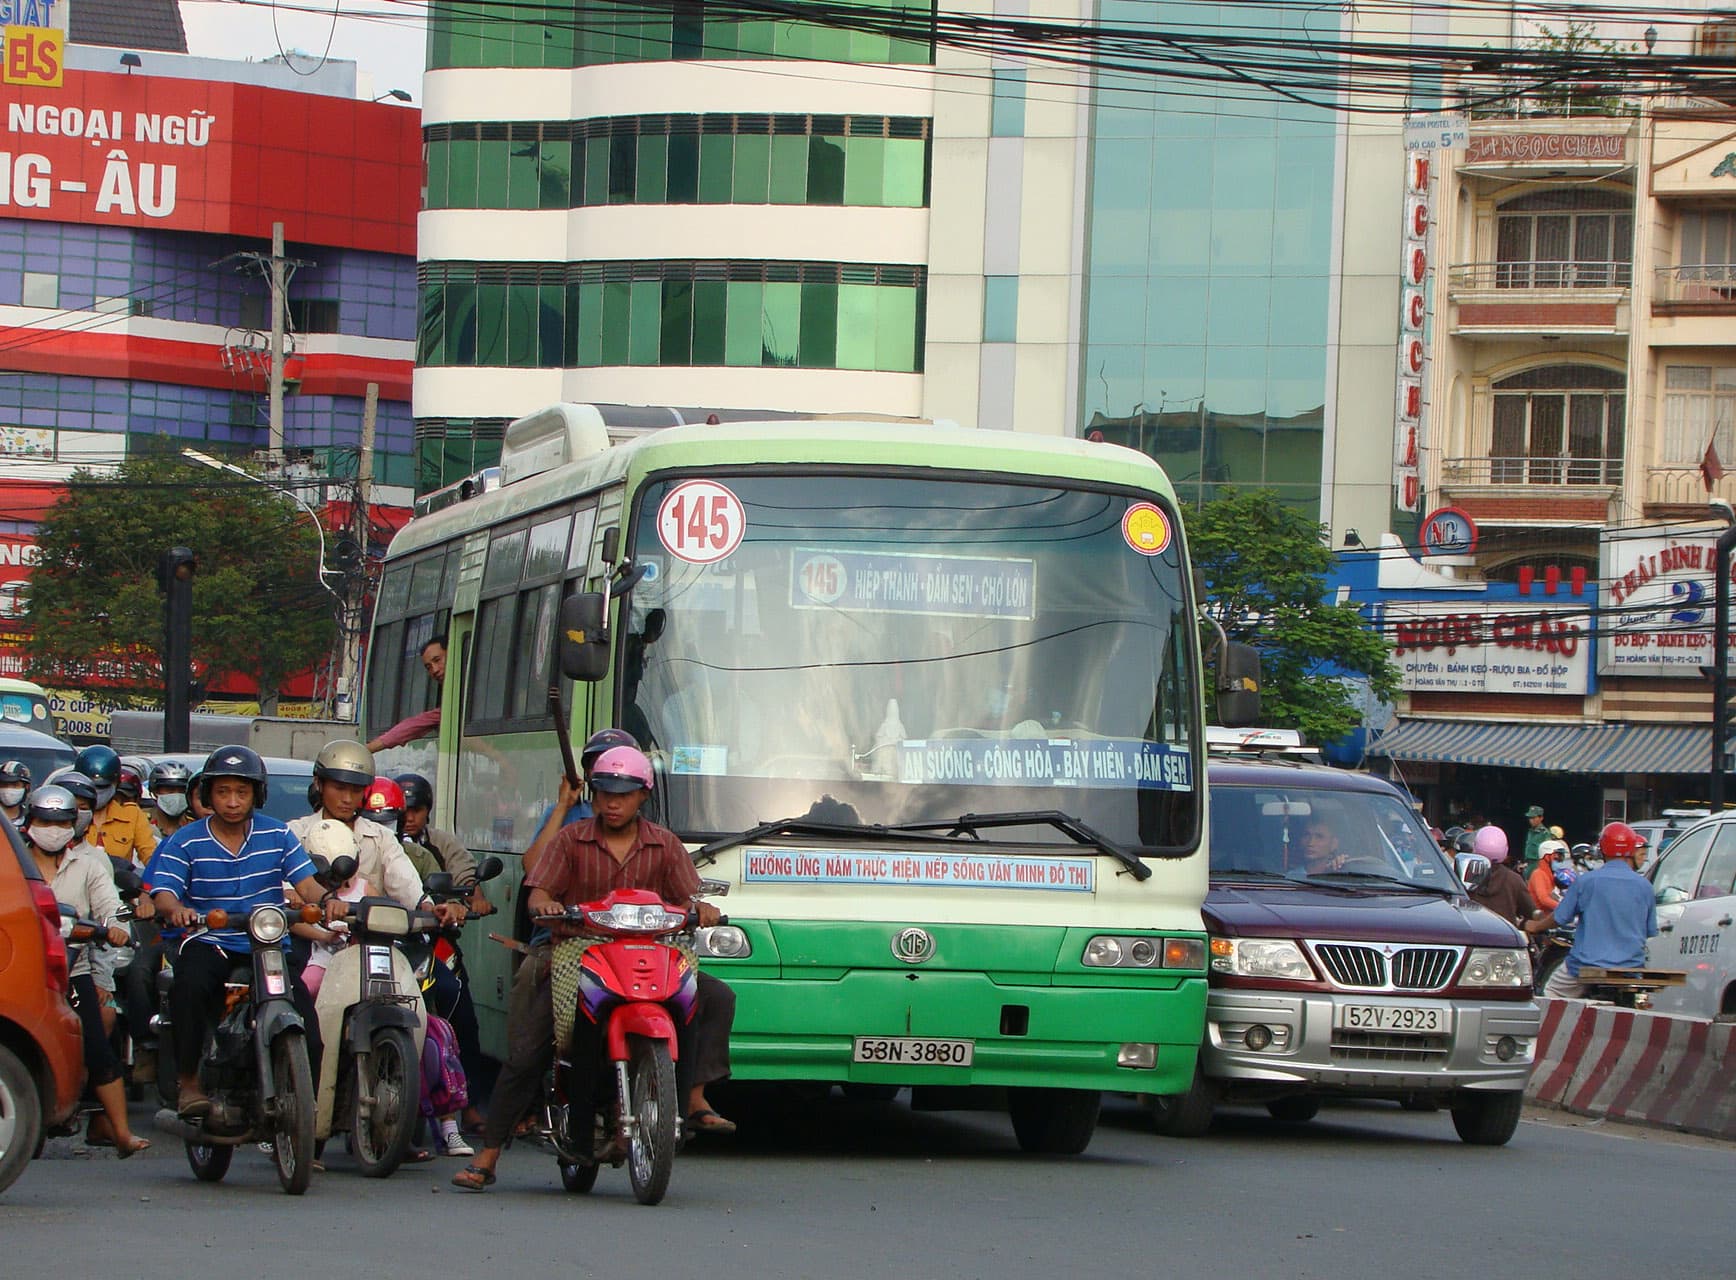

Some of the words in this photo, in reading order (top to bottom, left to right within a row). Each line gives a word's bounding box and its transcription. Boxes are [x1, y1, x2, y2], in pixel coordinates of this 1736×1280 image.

[9, 33, 57, 81] ELS
[8, 102, 123, 146] NGOẠI
[135, 109, 216, 147] NGỮ
[1440, 132, 1452, 148] 5
[95, 149, 177, 218] ÂU
[671, 494, 730, 550] 145
[803, 562, 839, 596] 145
[855, 563, 880, 608] HIỆP
[952, 573, 973, 605] SEN
[904, 751, 923, 780] AN
[926, 746, 974, 780] SƯƠNG
[984, 744, 1023, 779] CÔNG
[1025, 744, 1053, 779] HÒA
[1064, 742, 1089, 779] BẢY
[1093, 742, 1125, 780] HIỀN
[1134, 744, 1162, 783] ĐẦM
[1163, 751, 1187, 785] SEN
[750, 850, 792, 876] HƯỞNG
[795, 853, 820, 877] ỨNG
[826, 855, 852, 878] NĂM
[855, 855, 888, 881] THỰC
[892, 857, 921, 882] HIỆN
[925, 857, 949, 880] NẾP
[952, 857, 985, 881] SỐNG
[988, 860, 1012, 882] VĂN
[1015, 863, 1045, 884] MINH
[1049, 862, 1066, 885] ĐÔ
[1068, 866, 1088, 889] THỊ
